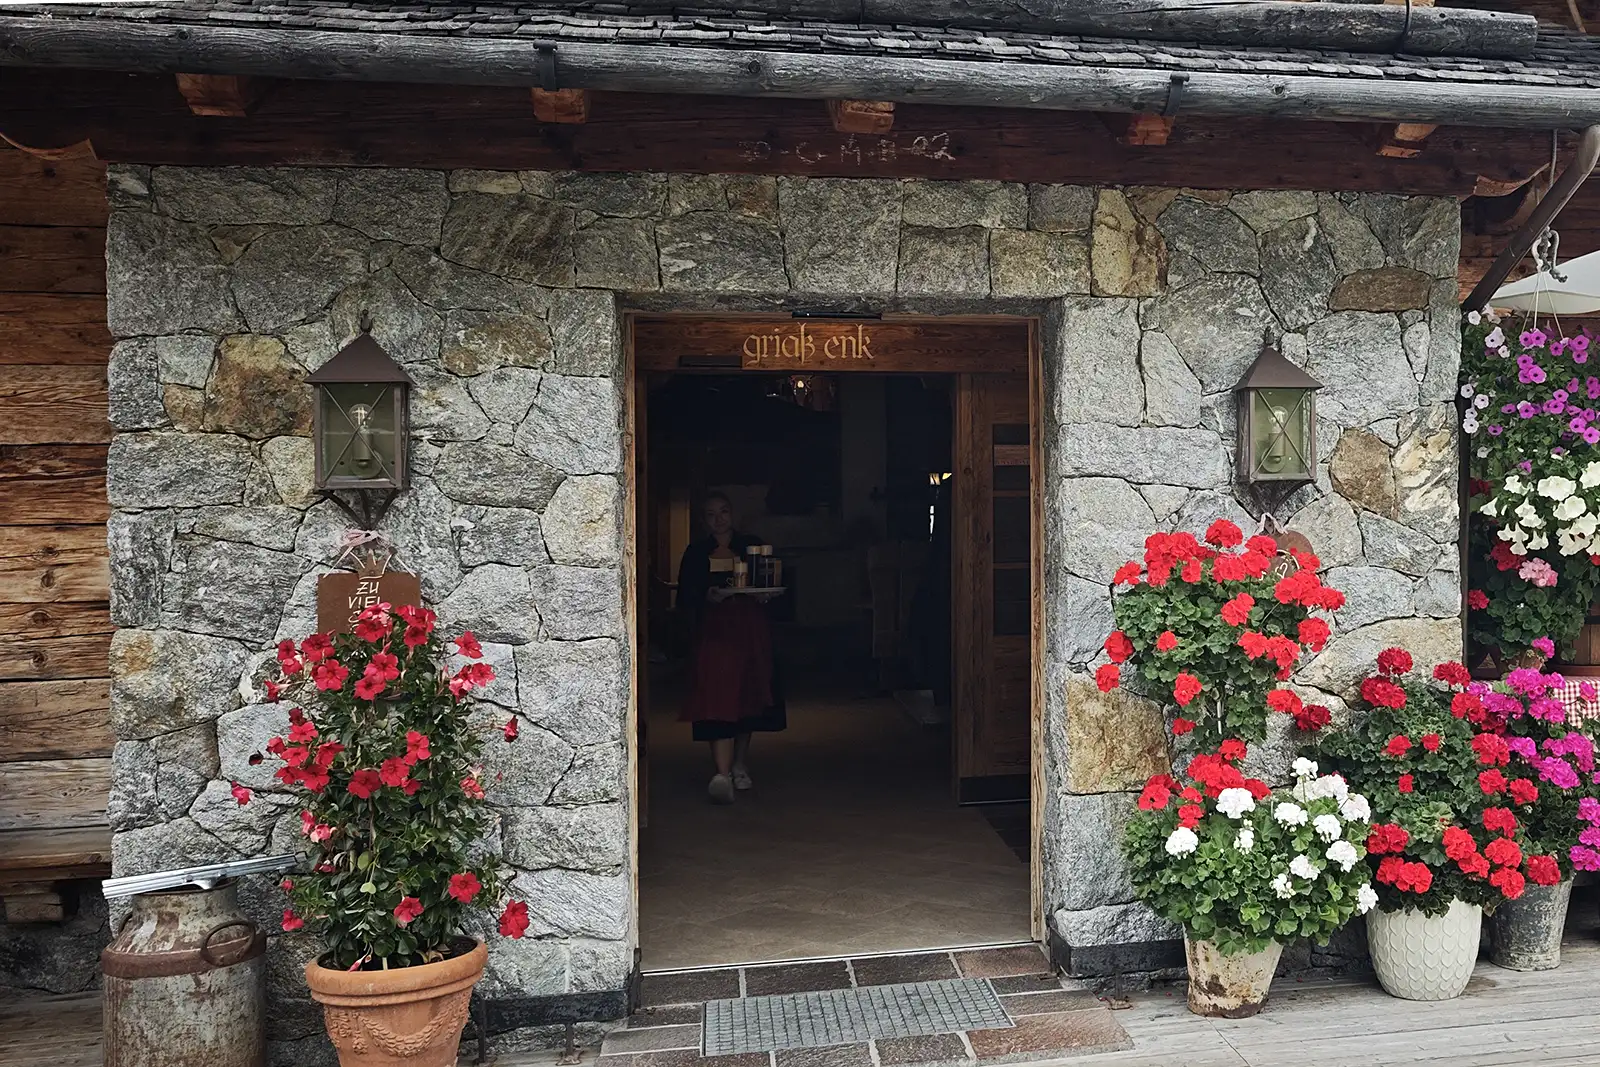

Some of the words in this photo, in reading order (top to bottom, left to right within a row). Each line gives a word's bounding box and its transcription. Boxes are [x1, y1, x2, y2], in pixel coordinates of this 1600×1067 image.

[743, 322, 816, 366] griaß
[824, 323, 876, 360] enk
[356, 581, 380, 595] ZU
